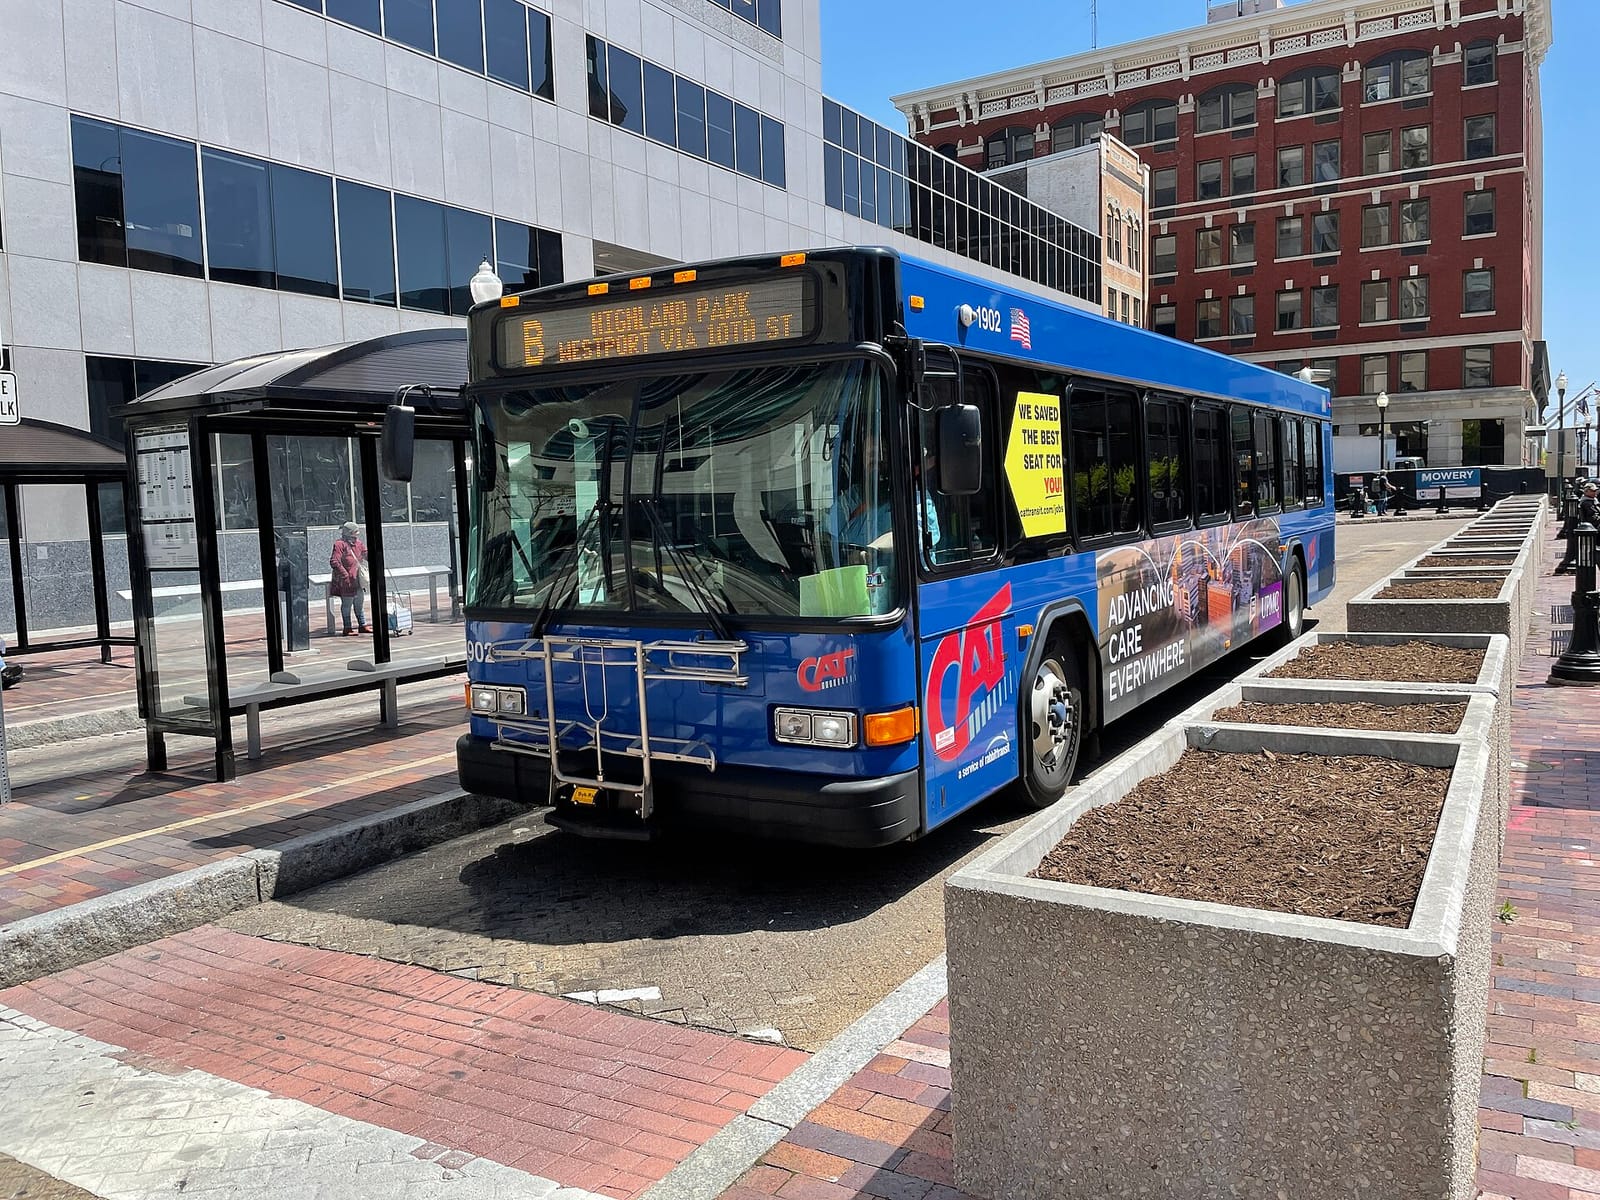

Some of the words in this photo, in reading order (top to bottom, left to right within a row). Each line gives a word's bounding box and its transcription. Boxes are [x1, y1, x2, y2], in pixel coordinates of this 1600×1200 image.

[591, 300, 687, 335] HIGHLAND
[696, 291, 751, 321] PARK
[976, 305, 1001, 332] 1902
[522, 320, 545, 366] B
[558, 333, 649, 363] WESTPORT
[660, 325, 696, 350] VIA
[707, 320, 756, 345] 10TH
[766, 313, 794, 338] ST
[1018, 403, 1032, 420] WE
[1034, 404, 1059, 422] SAVED
[1022, 429, 1038, 445] THE
[1041, 430, 1060, 446] BEST
[1023, 454, 1043, 470] SEAT
[1046, 454, 1062, 469] FOR
[1421, 470, 1474, 482] MOWERY
[1044, 477, 1063, 494] YOU!
[1108, 580, 1174, 627] ADVANCING
[1261, 591, 1280, 619] UPMC
[1108, 624, 1143, 665] CARE
[796, 647, 855, 692] CAT
[926, 580, 1013, 763] CAT
[1109, 638, 1185, 702] EVERYWHERE
[962, 760, 979, 778] service
[979, 756, 985, 769] of
